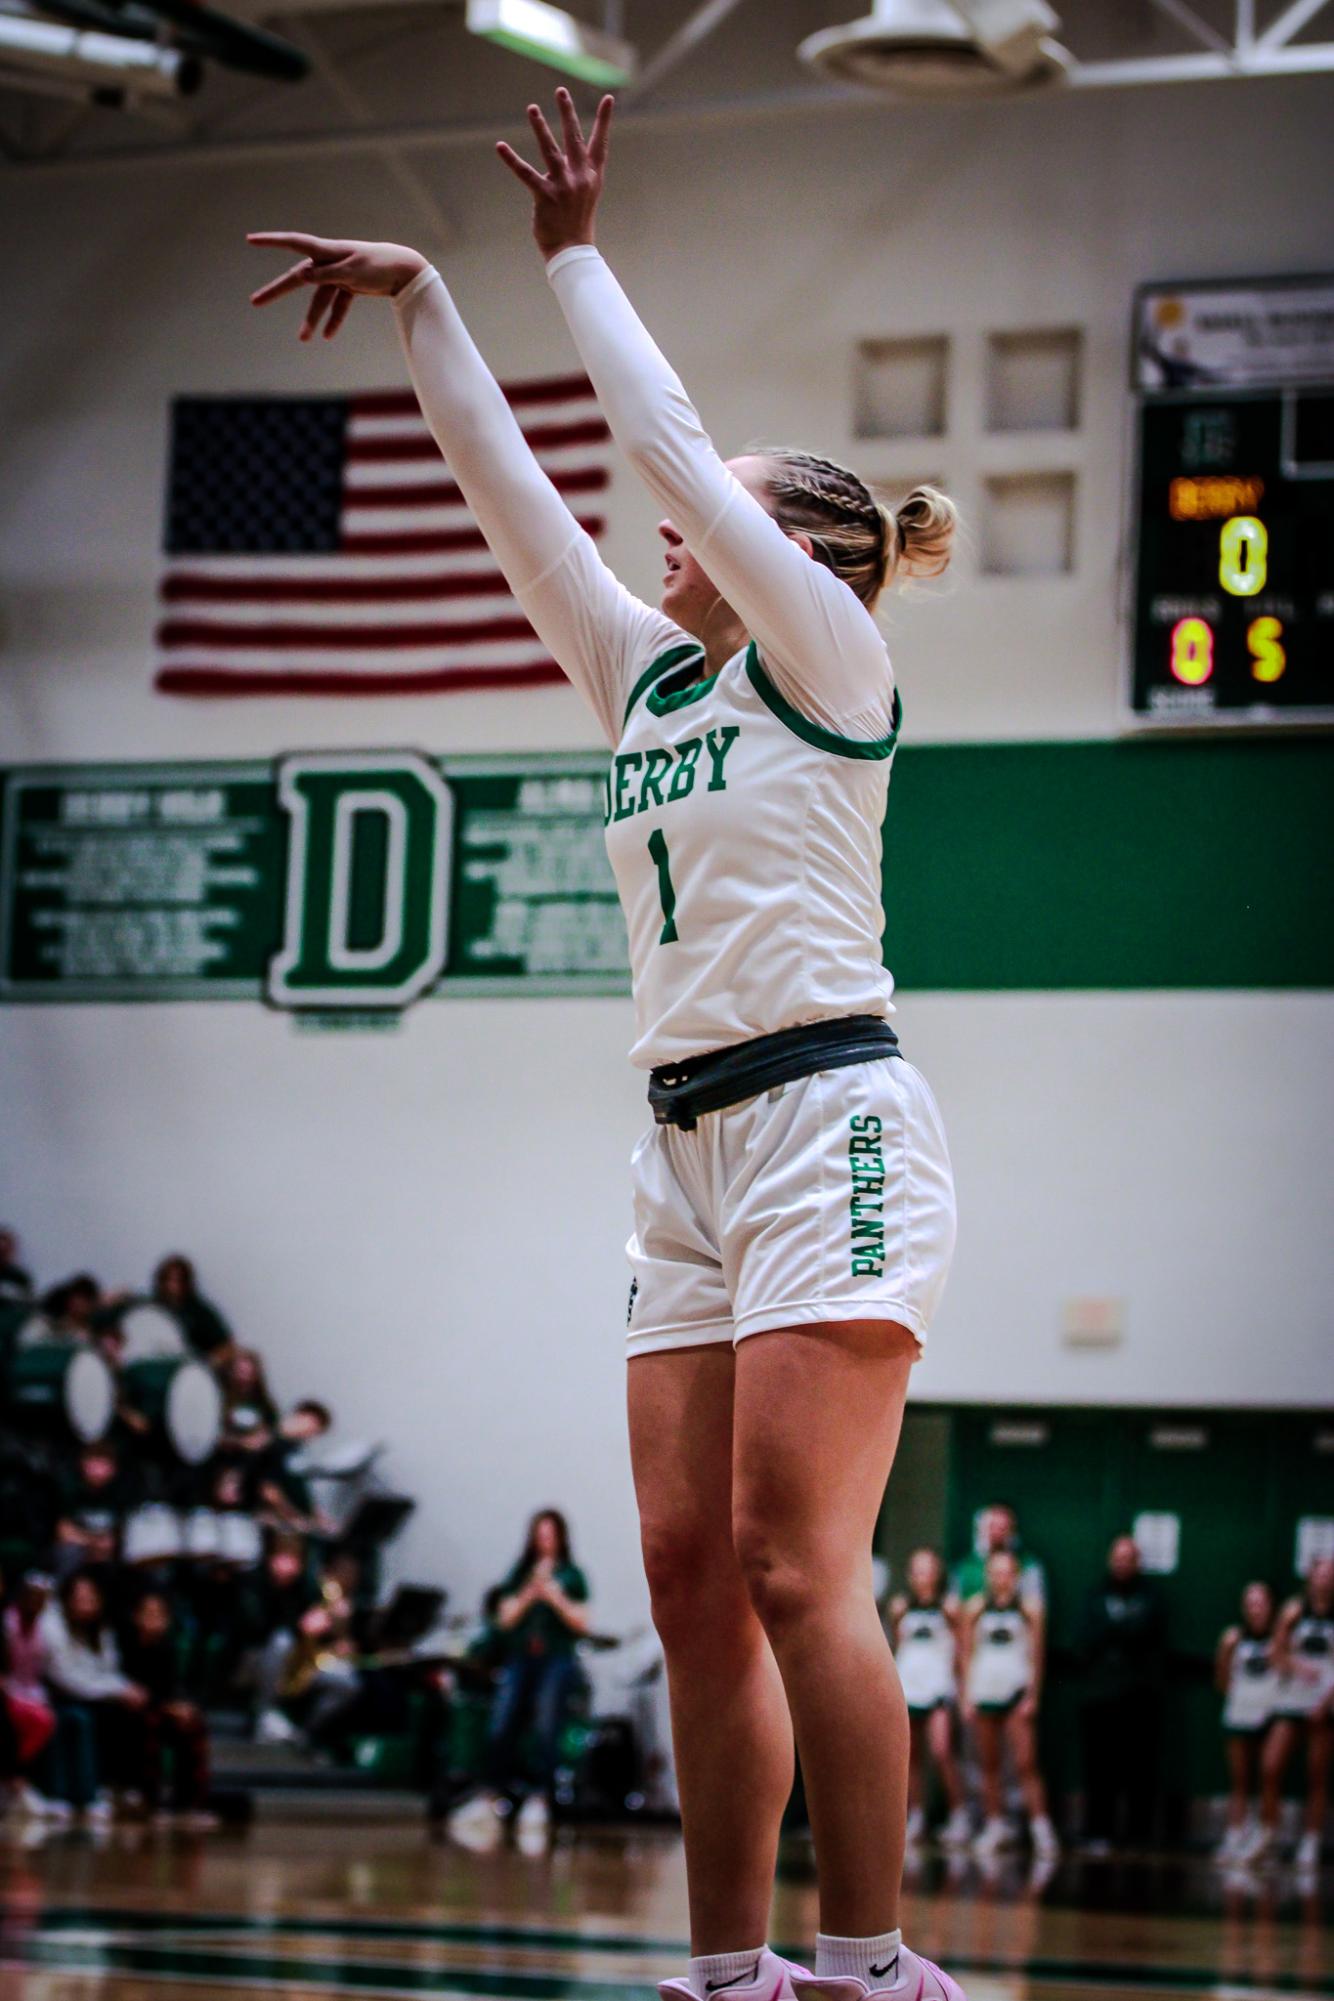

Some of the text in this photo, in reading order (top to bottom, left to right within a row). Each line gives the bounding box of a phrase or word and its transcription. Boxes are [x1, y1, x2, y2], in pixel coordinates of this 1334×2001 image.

[1219, 516, 1268, 596] 0
[1171, 617, 1213, 685] 0
[268, 750, 455, 1008] D
[647, 828, 679, 945] 1
[848, 1115, 885, 1278] PANTHERS
